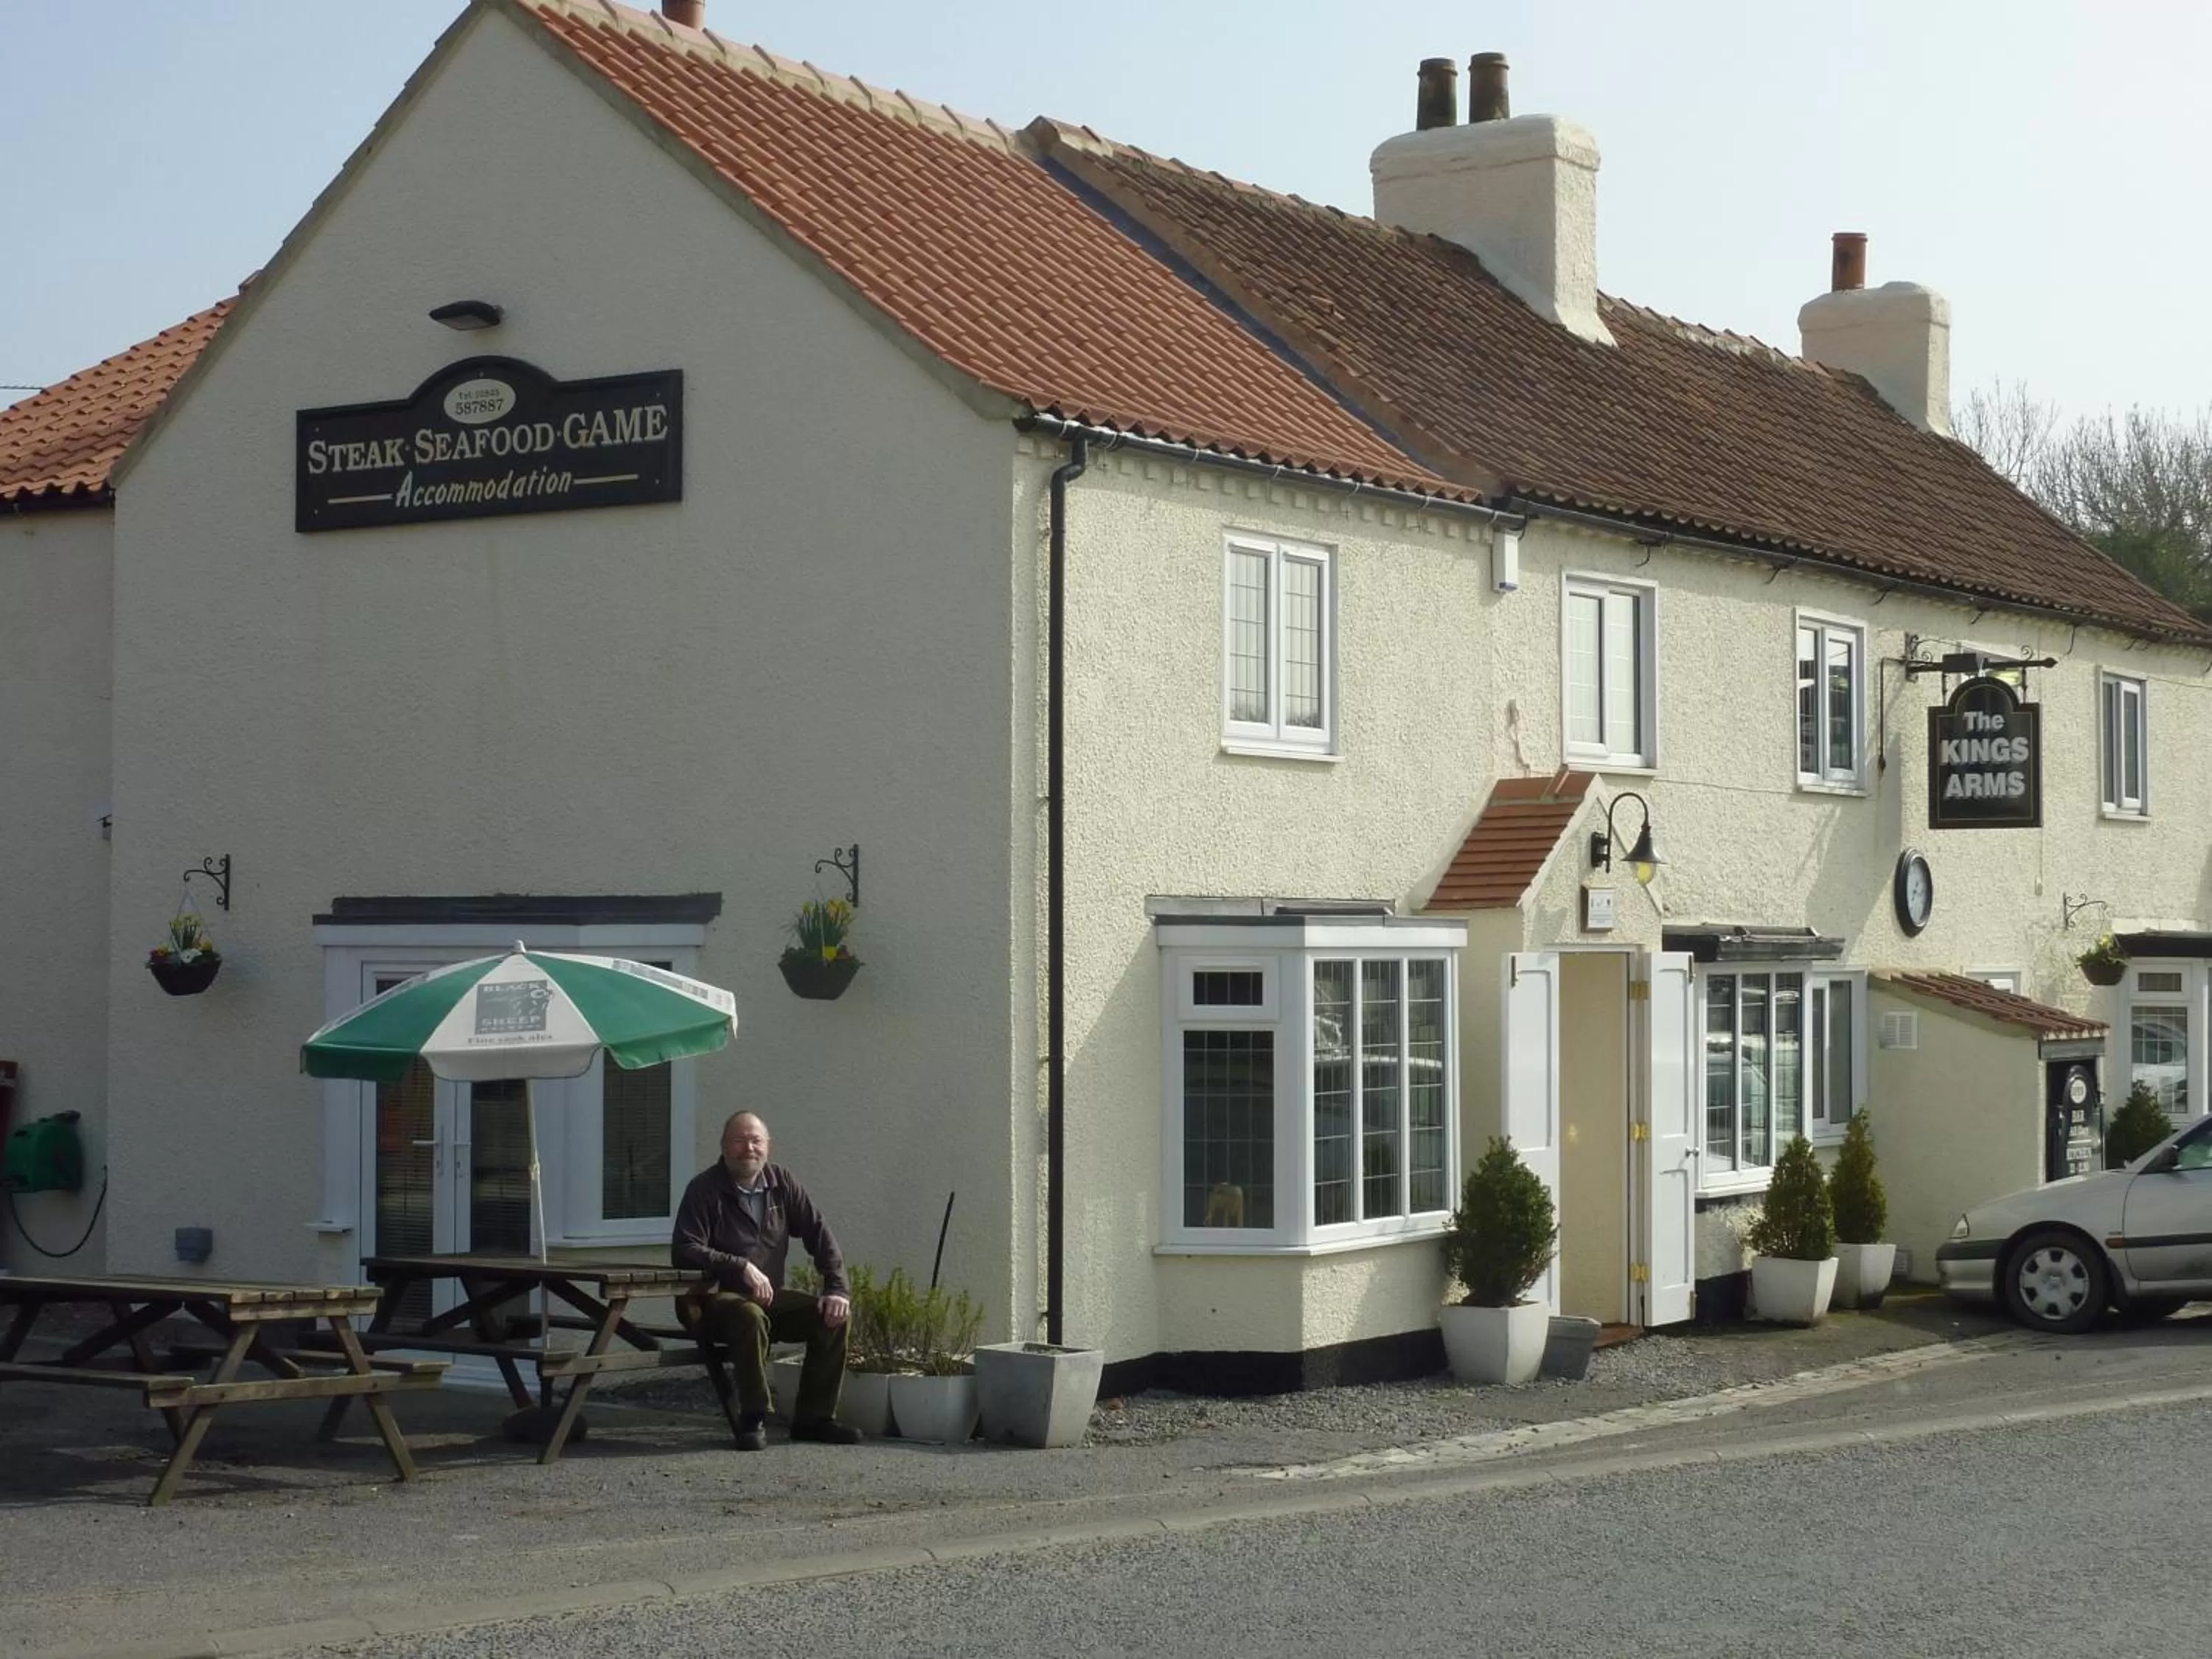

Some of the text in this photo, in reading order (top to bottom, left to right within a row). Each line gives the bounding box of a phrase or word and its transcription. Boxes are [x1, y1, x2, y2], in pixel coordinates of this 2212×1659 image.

[307, 405, 668, 474] STEAK SEAFOOD GAME
[394, 466, 574, 507] Accommodation
[1963, 711, 2006, 731] The
[1940, 737, 2029, 765] KINGS
[1944, 771, 2025, 799] ARMS
[481, 1015, 540, 1026] SHEEP
